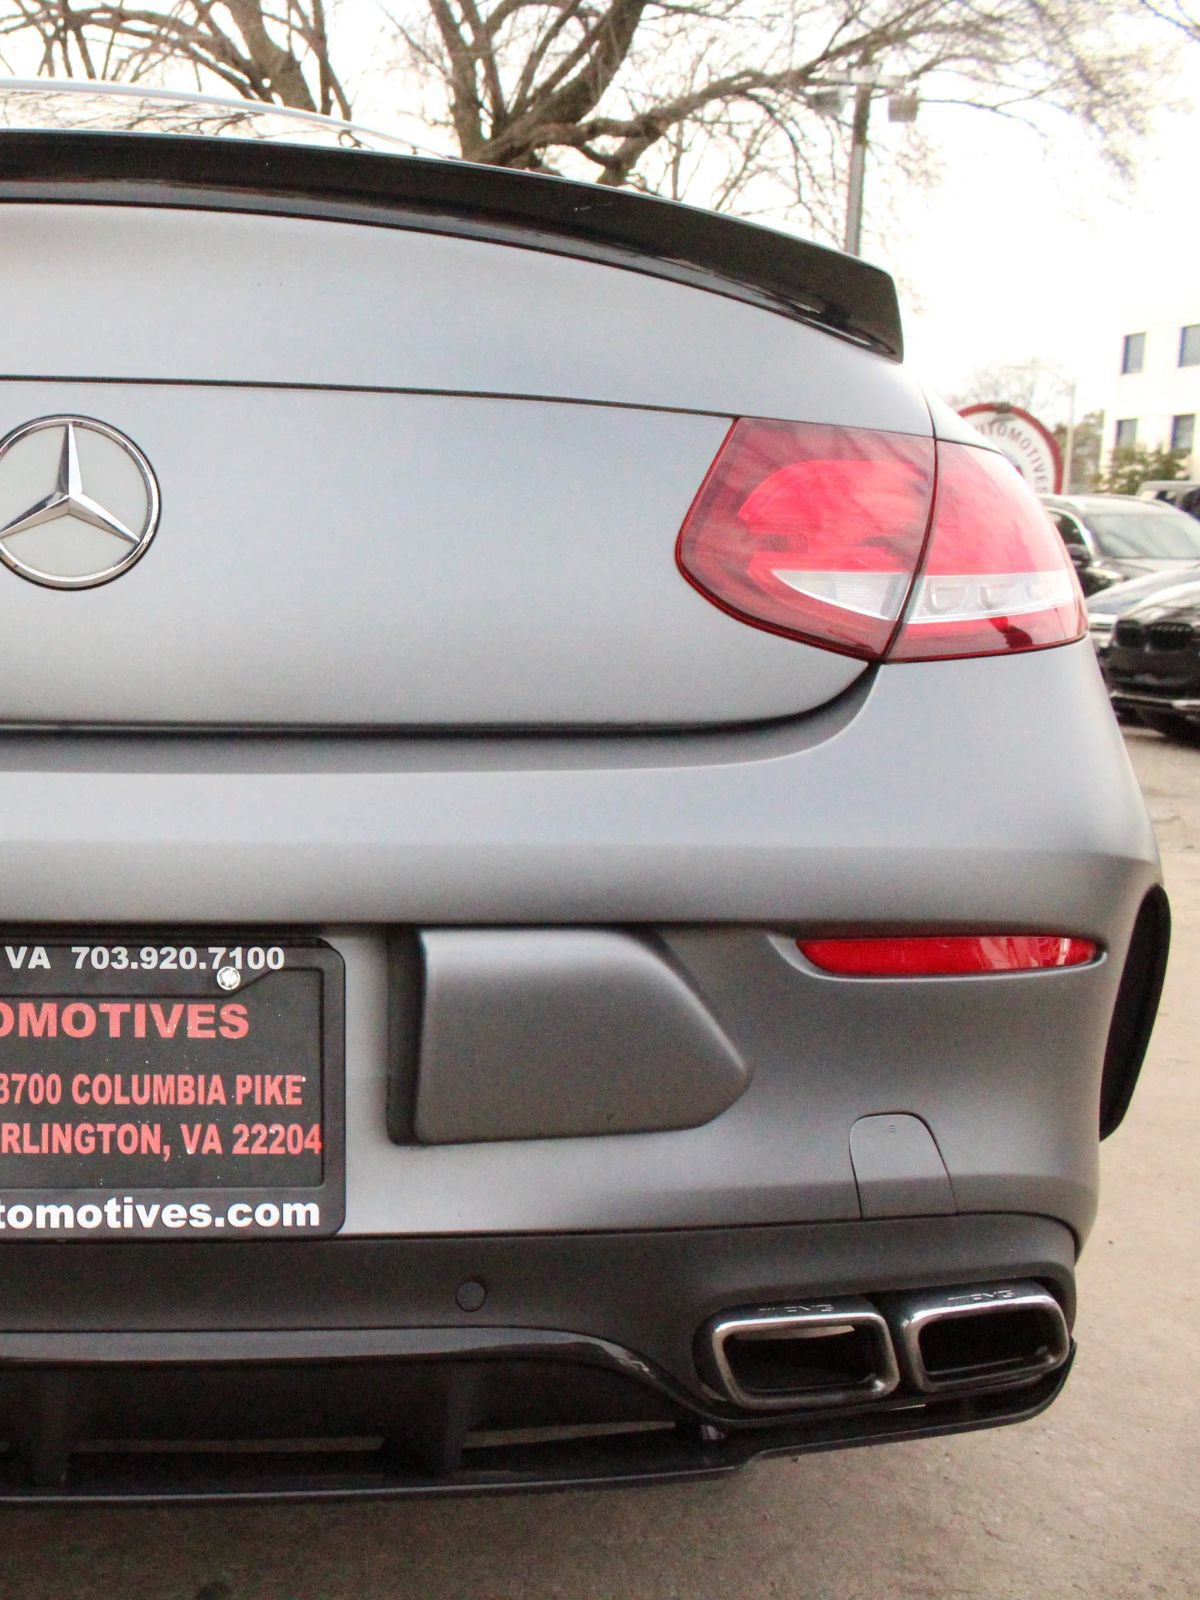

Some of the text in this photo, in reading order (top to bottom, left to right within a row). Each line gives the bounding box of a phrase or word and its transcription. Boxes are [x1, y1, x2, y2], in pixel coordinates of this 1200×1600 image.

[4, 946, 52, 970] VA
[71, 945, 285, 971] 703.920.7100
[71, 1073, 228, 1106] COLUMBIA
[235, 1073, 304, 1106] PIKE
[180, 1123, 224, 1155] VA
[232, 1122, 324, 1156] 22204
